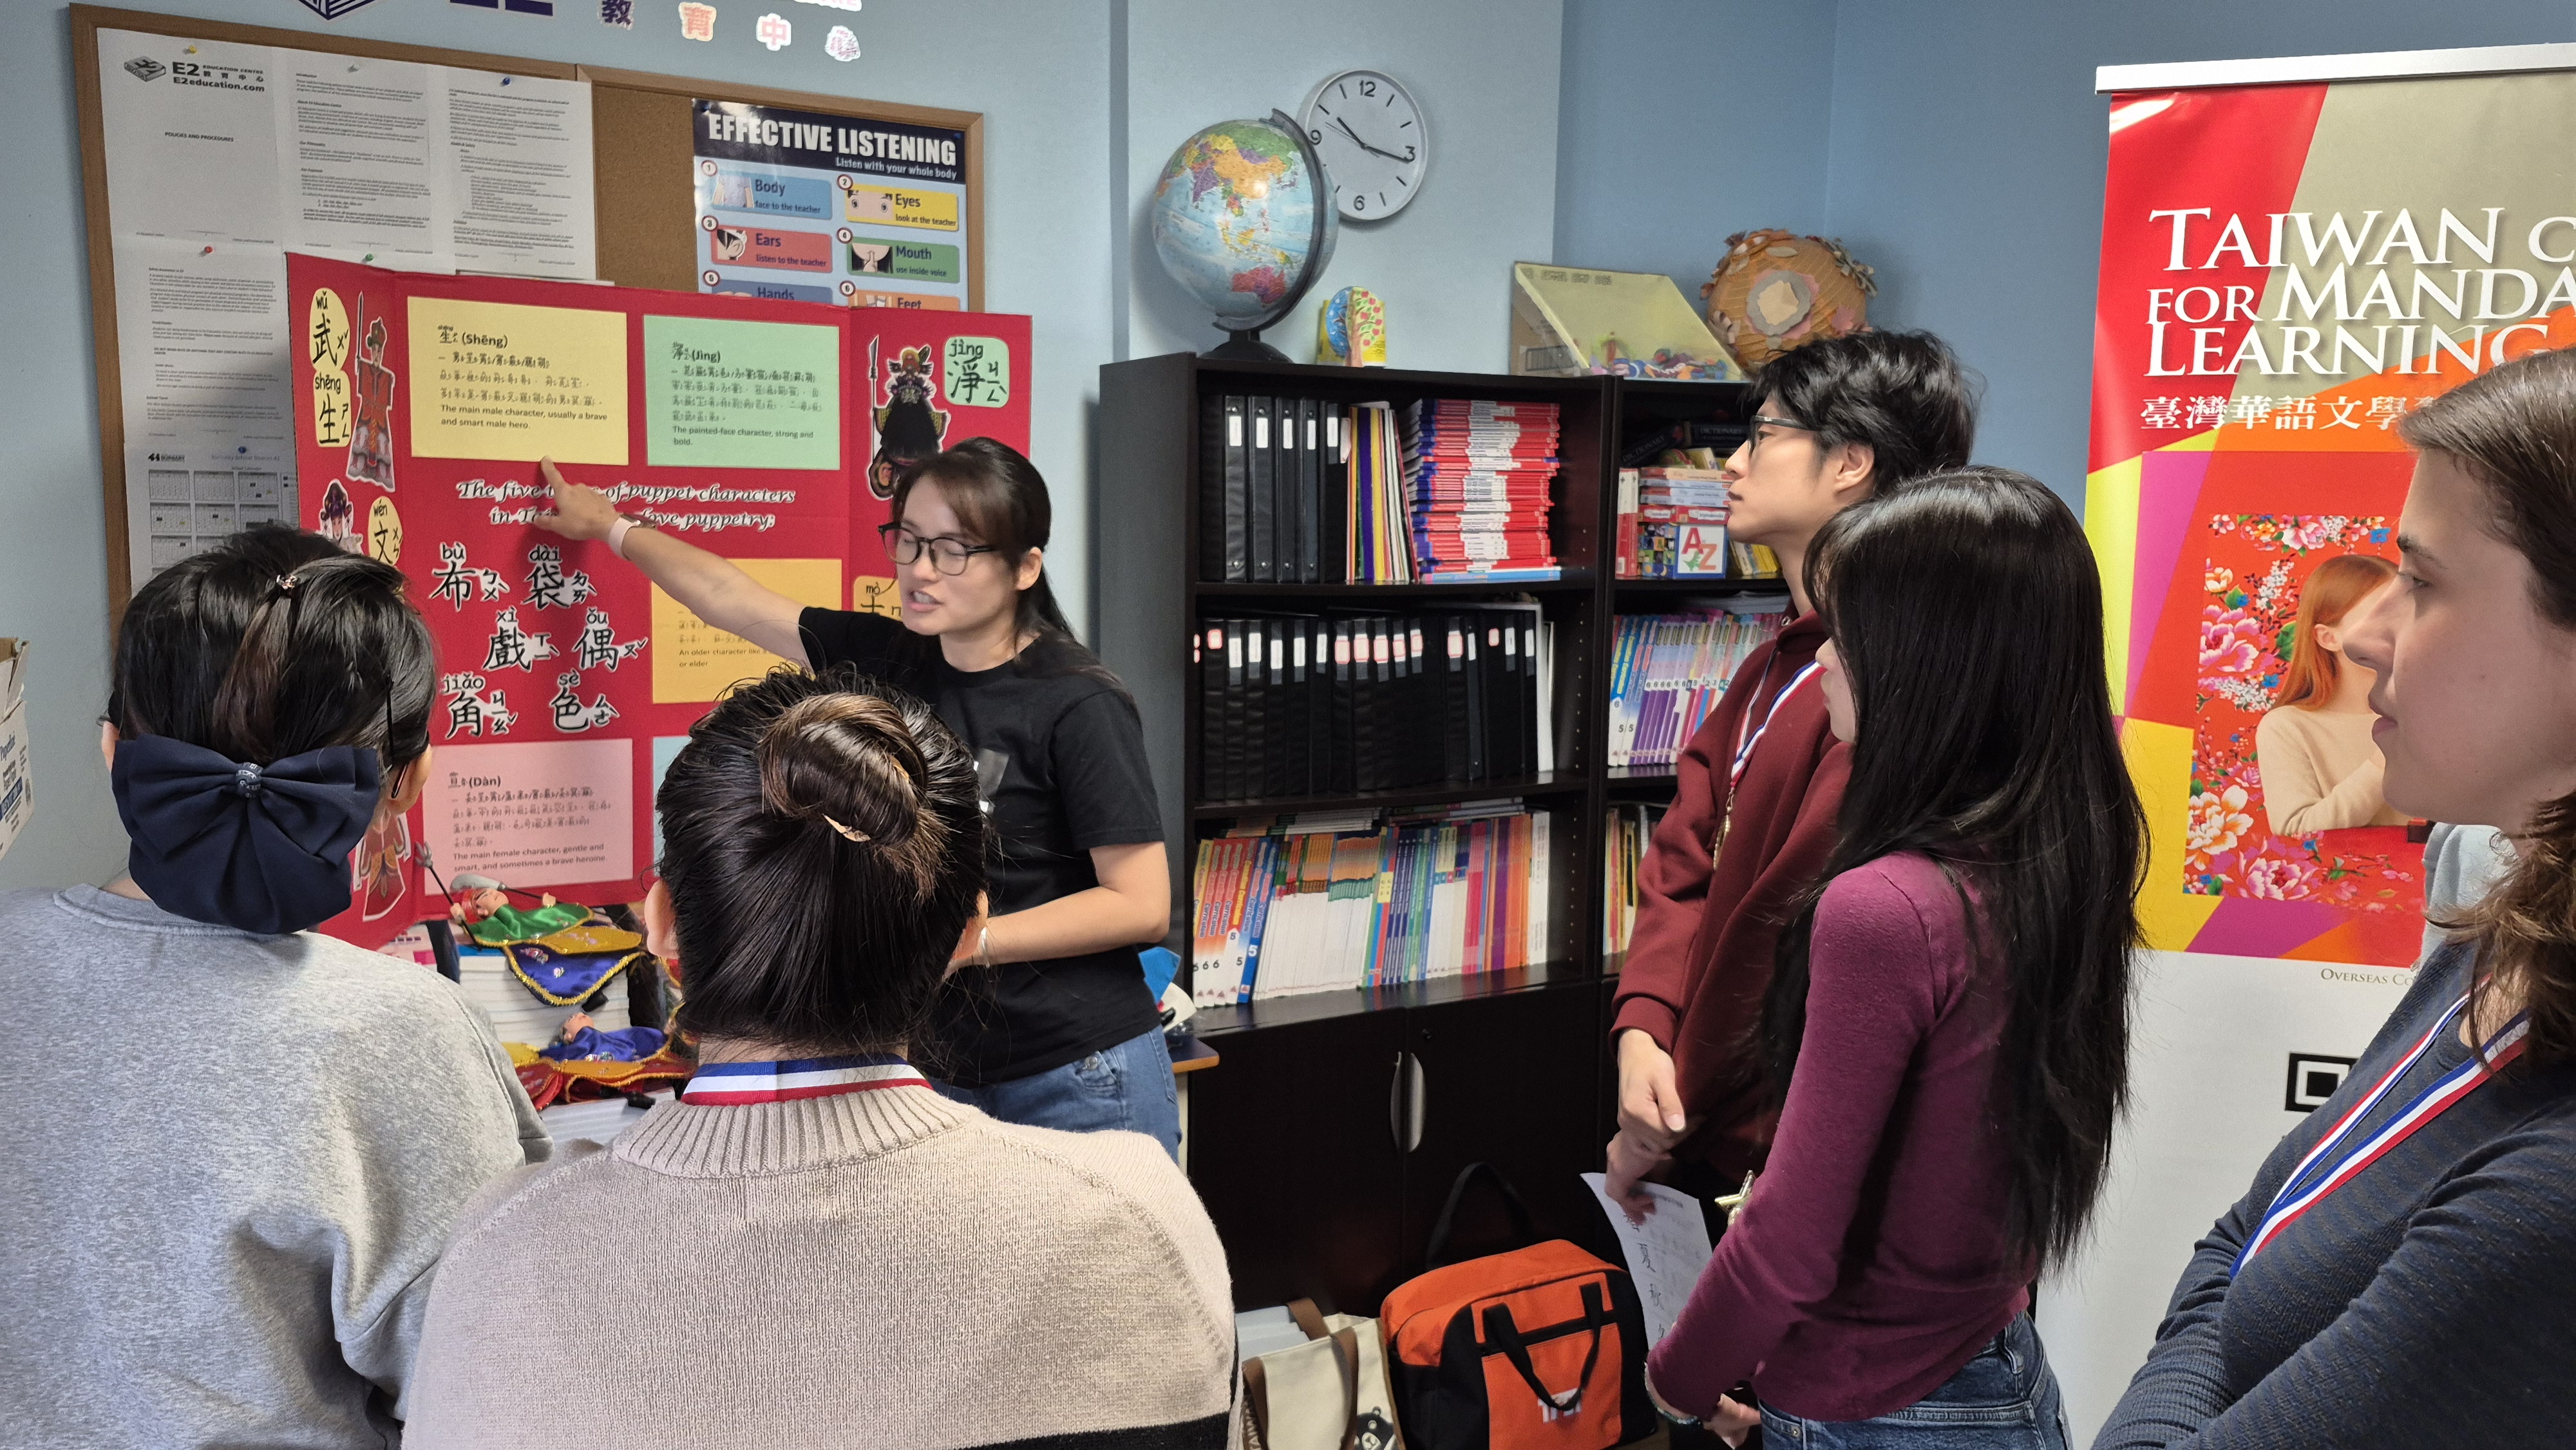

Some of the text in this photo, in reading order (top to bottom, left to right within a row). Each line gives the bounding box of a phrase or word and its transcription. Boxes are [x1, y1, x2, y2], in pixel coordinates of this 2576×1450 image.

[172, 61, 200, 77] E2
[173, 76, 265, 92] E2education.com
[1360, 80, 1376, 97] 12
[201, 134, 234, 142] PROCEDURES
[708, 113, 956, 166] EFFECTIVE LISTENING
[1310, 129, 1322, 145] 9
[1405, 146, 1416, 162] 3
[836, 157, 958, 181] Listen with your whole body
[755, 179, 785, 197] Body
[842, 178, 848, 187] 2
[755, 201, 821, 214] face to the teacher
[895, 193, 921, 208] Eyes
[1354, 195, 1365, 211] 6
[707, 219, 713, 228] 3
[895, 213, 909, 223] look
[920, 216, 931, 225] the
[932, 217, 957, 227] teacher
[756, 232, 782, 248] Ears
[842, 231, 848, 240] 4
[2149, 207, 2506, 272] TAIWAN
[896, 245, 932, 260] Mouth
[756, 254, 827, 268] listen to the teacher
[896, 266, 947, 278] use inside voice
[758, 286, 795, 301] Hands
[897, 297, 922, 310] Feet
[2146, 285, 2268, 325] FOR
[312, 313, 337, 366] 武
[462, 332, 508, 348] (Shēng)
[949, 339, 984, 360] jìng
[315, 375, 341, 393] shēng
[947, 355, 985, 404] 淨
[319, 393, 341, 444] 生
[482, 407, 503, 415] male
[505, 408, 545, 419] character,
[548, 410, 576, 420] usually
[585, 412, 607, 420] brave
[486, 420, 507, 428] male
[674, 437, 693, 446] bold.
[737, 429, 773, 438] character,
[775, 430, 799, 439] strong
[458, 480, 495, 498] The
[497, 480, 540, 503] five
[605, 483, 627, 503] of
[623, 485, 693, 504] puppet
[699, 484, 795, 502] characters
[491, 507, 511, 523] in
[643, 509, 775, 531] love puppetry:
[374, 520, 393, 565] 文
[1681, 527, 1718, 570] A Z
[442, 543, 464, 559] bù
[530, 545, 560, 561] dài
[431, 561, 475, 610] 布
[523, 565, 569, 608] 袋
[497, 608, 516, 623] xì
[587, 608, 608, 624] ǒu
[483, 626, 531, 670] 戲
[574, 628, 618, 670] 偶
[443, 673, 484, 692] jiǎo
[559, 671, 579, 686] sè
[448, 692, 482, 739] 角
[551, 688, 588, 731] 色
[1618, 724, 1624, 733] 5
[1629, 724, 1634, 732] 5
[469, 775, 501, 788] (Dàn)
[470, 851, 491, 860] main
[493, 849, 520, 858] female
[522, 847, 561, 857] character,
[563, 845, 587, 854] gentle
[500, 860, 543, 869] sometimes
[553, 857, 574, 865] brave
[1199, 903, 1211, 937] Curriculum
[1209, 901, 1221, 936] Curriculum
[1220, 901, 1232, 934] Curriculum
[1244, 898, 1256, 932] Curriculum
[1253, 903, 1266, 937] Curriculum
[1249, 945, 1258, 957] 5
[1202, 961, 1209, 970] 6
[1213, 959, 1220, 968] 6
[1236, 957, 1243, 966] 5
[2321, 968, 2388, 984] OVERSEAS
